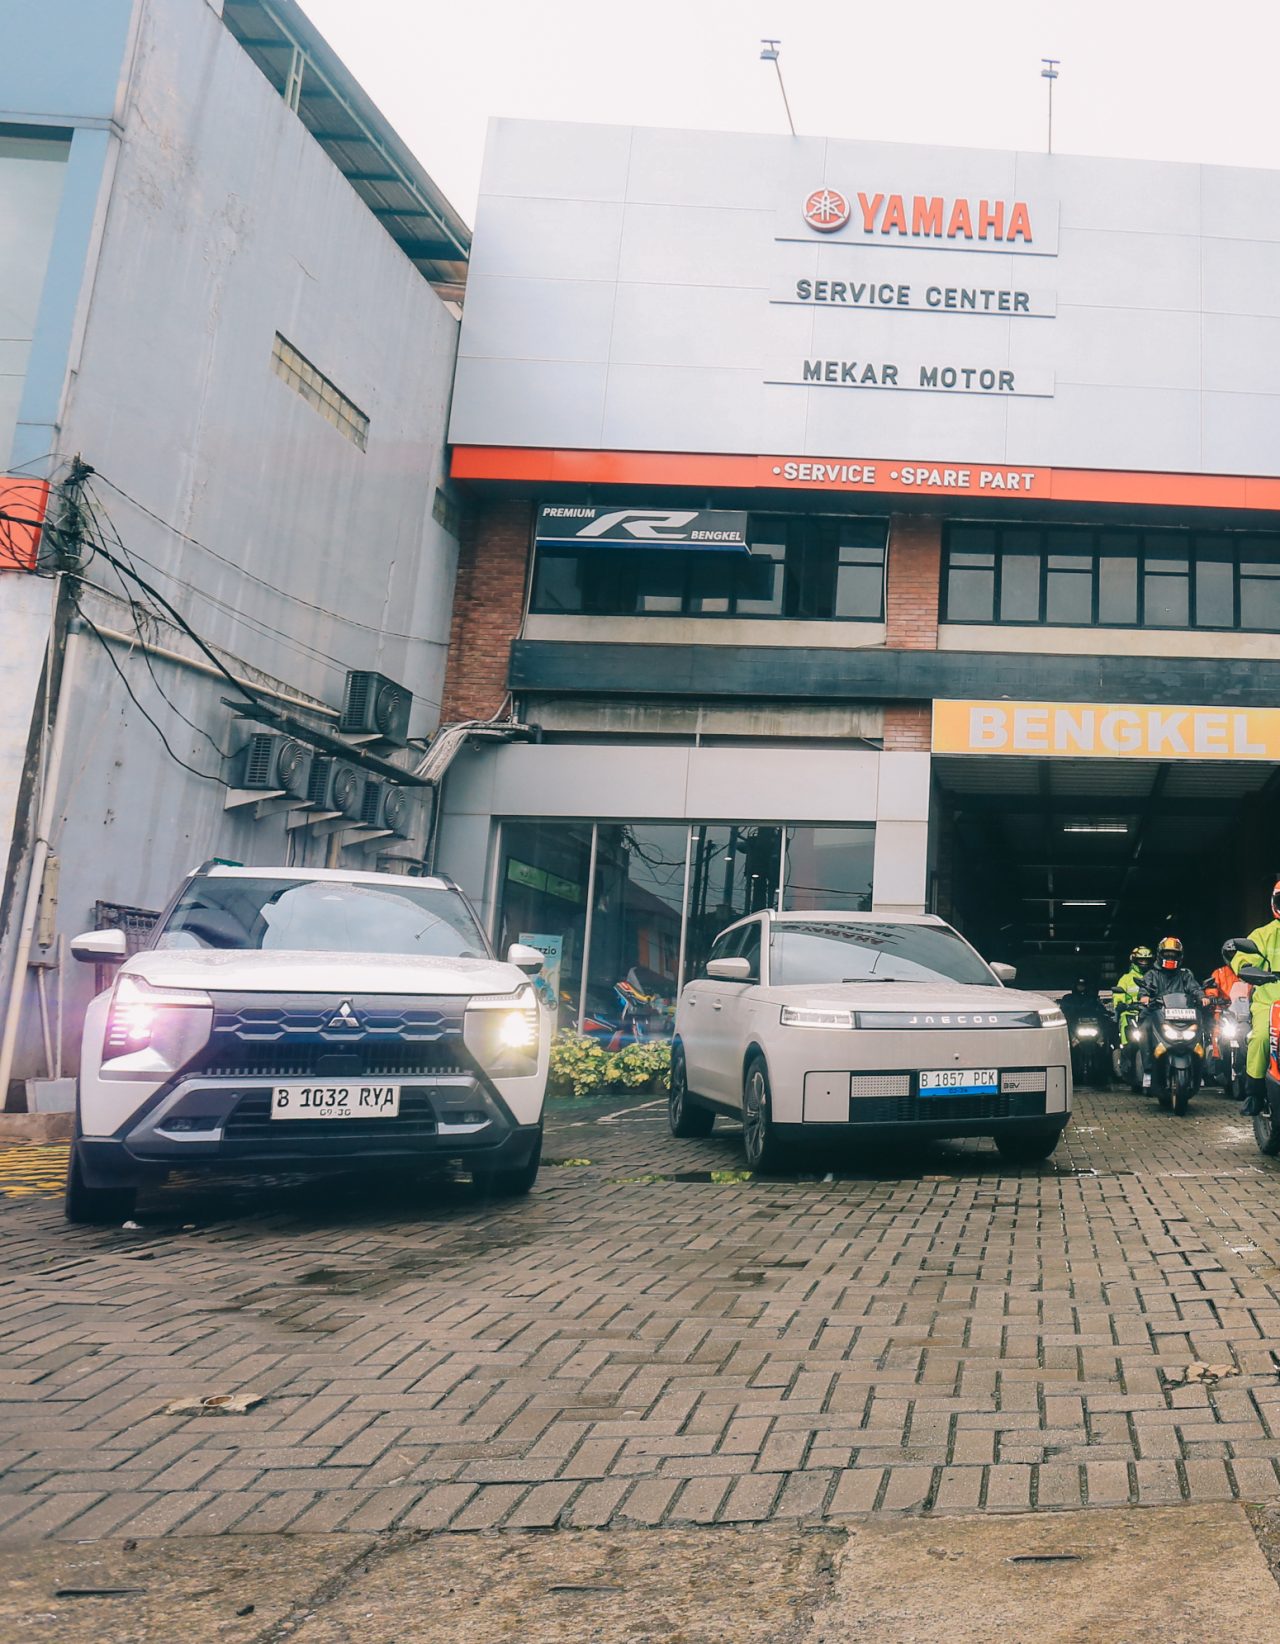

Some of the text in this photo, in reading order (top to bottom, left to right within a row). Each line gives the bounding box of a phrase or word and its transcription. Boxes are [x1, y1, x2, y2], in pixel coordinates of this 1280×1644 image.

[857, 192, 1033, 243] YAMAHA
[796, 279, 1030, 312] SERVICE CENTER
[803, 360, 1015, 391] MEKAR MOTOR
[979, 469, 1035, 490] PART
[542, 507, 596, 518] PREMIUM
[691, 530, 742, 541] BENGKEL
[968, 707, 1266, 755] BENGKEL
[908, 1016, 998, 1024] JAECOO
[921, 1071, 995, 1087] B 1857 PCK
[277, 1087, 394, 1108] B 1032 RYA
